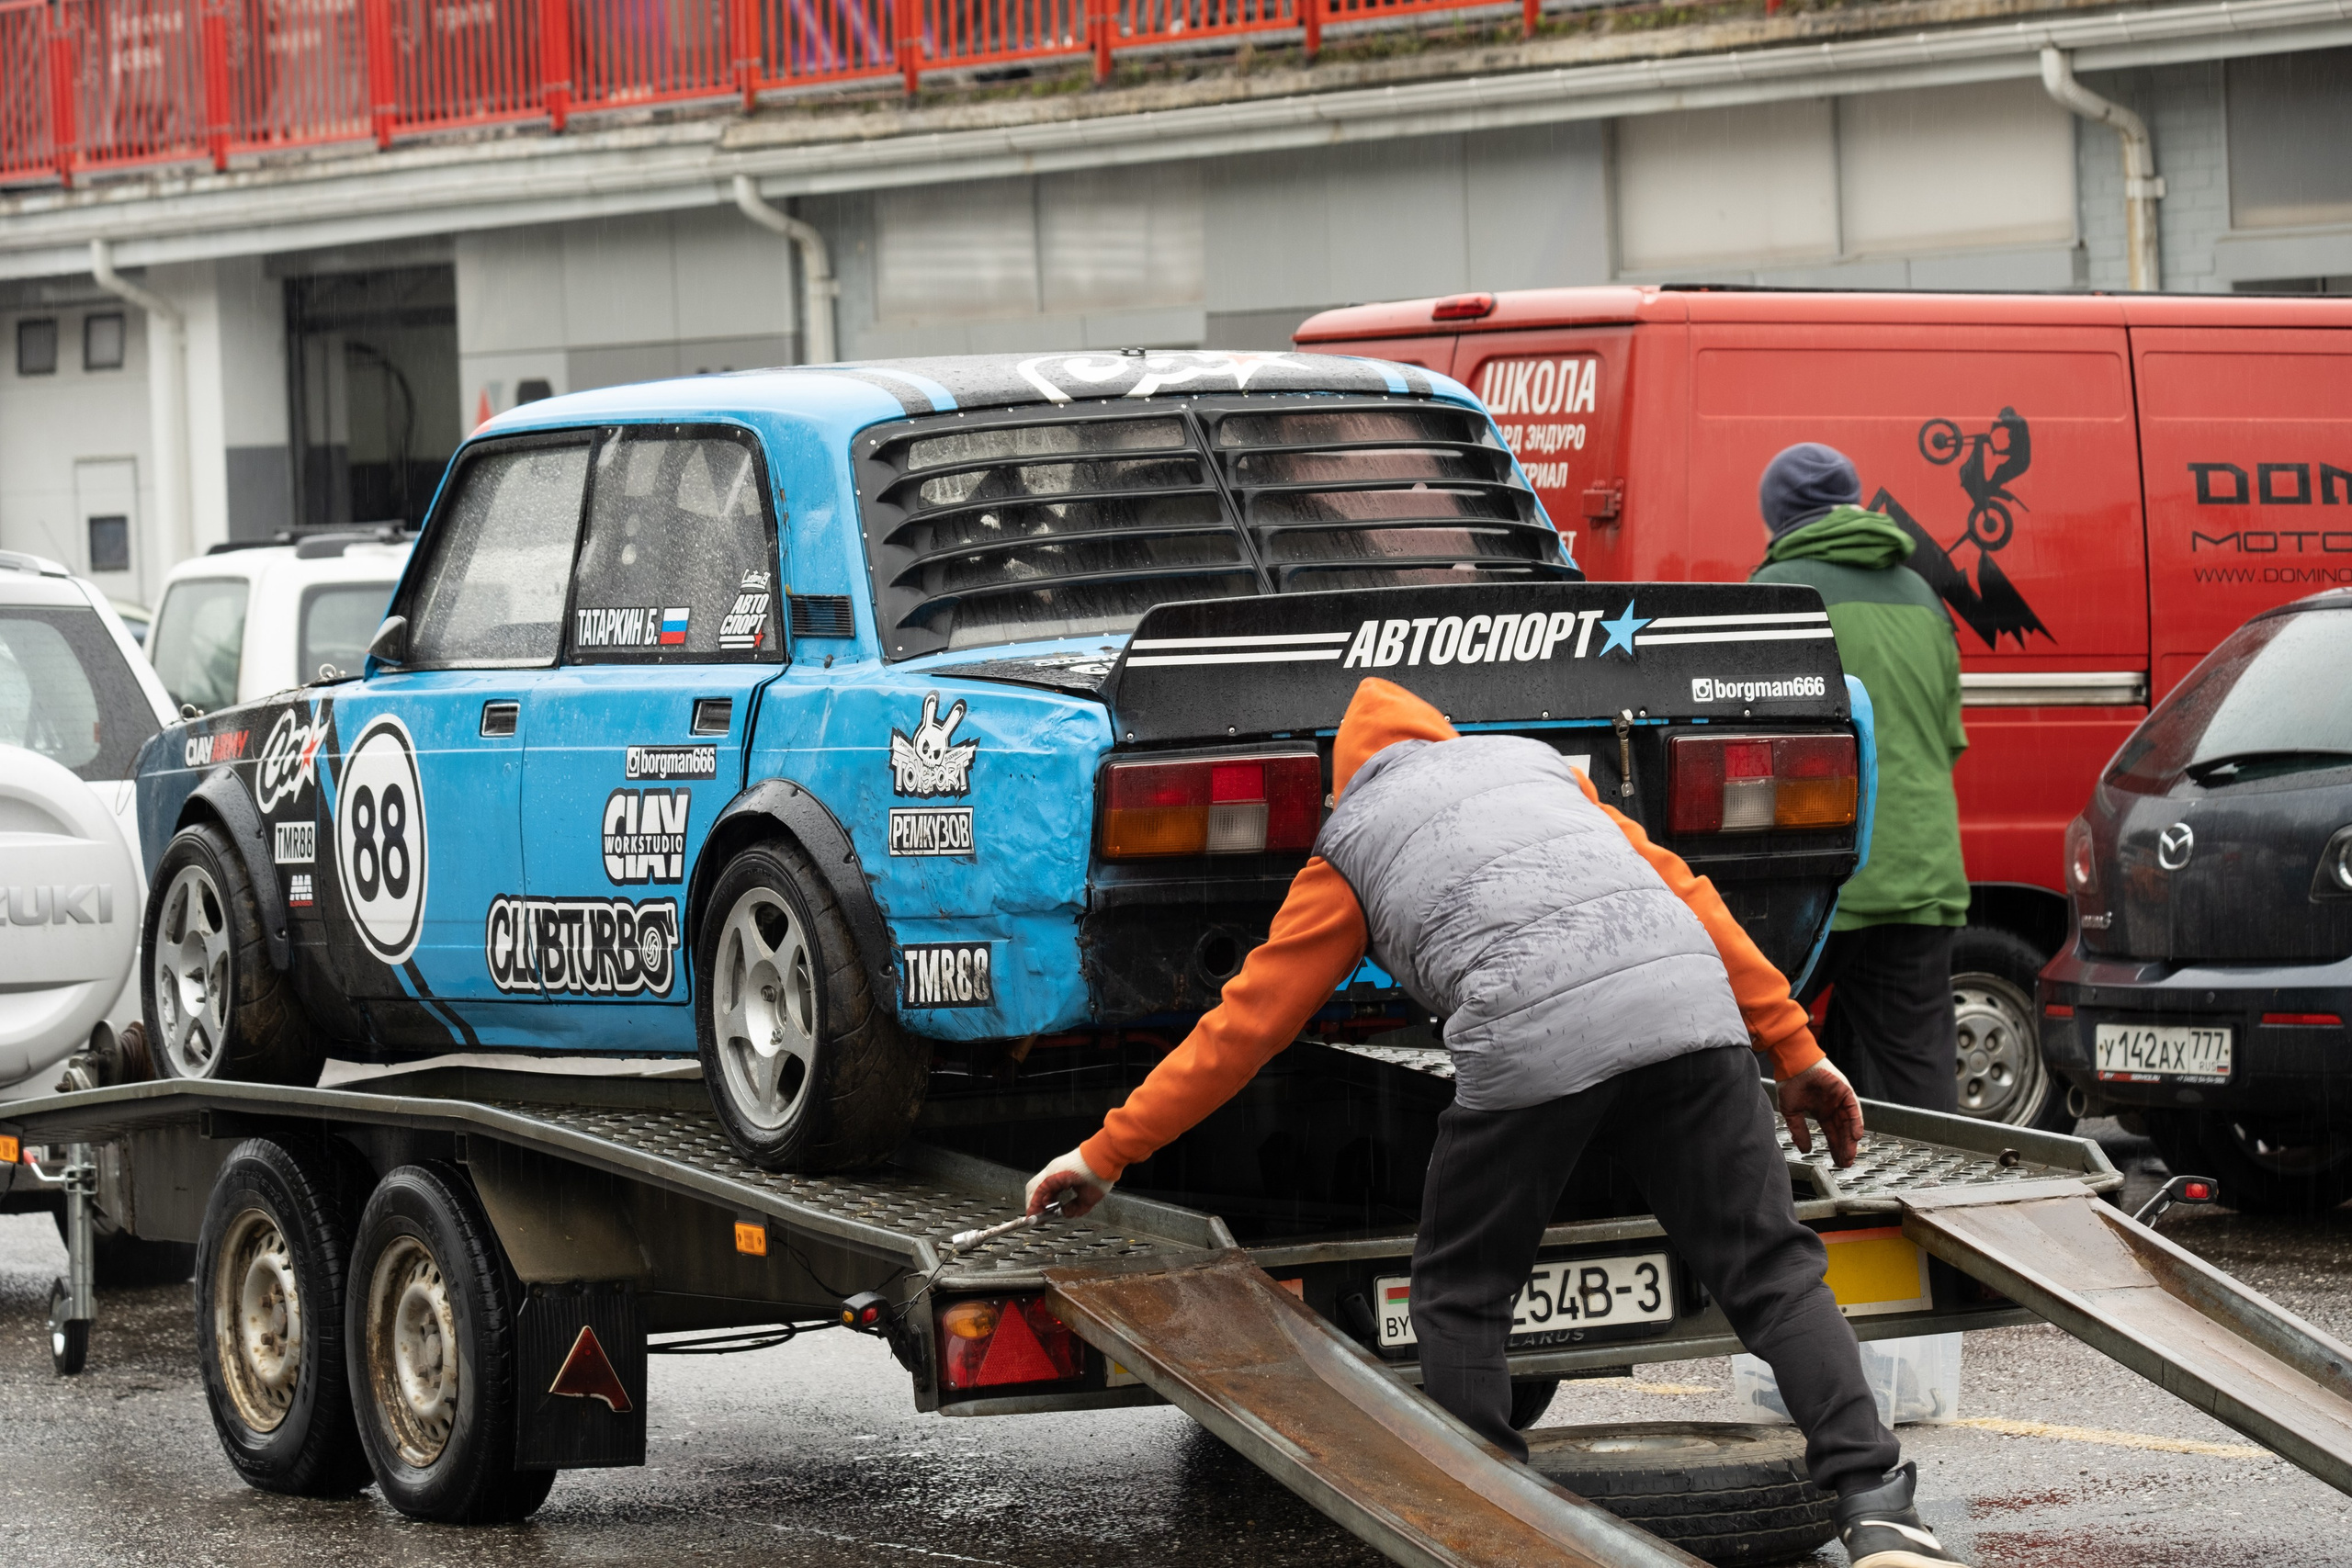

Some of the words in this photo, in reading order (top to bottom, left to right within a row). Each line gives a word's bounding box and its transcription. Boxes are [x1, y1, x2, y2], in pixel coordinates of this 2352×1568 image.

[1481, 359, 1597, 415] ШКОЛА
[1525, 423, 1586, 455] ЭНДУРО
[730, 593, 770, 615] АВТО
[578, 608, 644, 646] ТАТАРКИН
[644, 608, 658, 646] Б.
[719, 614, 767, 635] СПОРТ
[1343, 610, 1604, 669] АВТОСПОРТ
[1715, 676, 1826, 702] borgman666
[640, 748, 715, 779] borgman666
[277, 827, 313, 860] TMR88
[351, 783, 411, 902] 88
[605, 835, 683, 853] WORKSTUDIO
[892, 815, 970, 850] РЕМКУЗОВ
[0, 883, 113, 927] UKI
[904, 947, 990, 1004] TMR88
[2191, 1032, 2224, 1060] 777
[2199, 1061, 2217, 1072] RUS
[1385, 1316, 1409, 1338] BY
